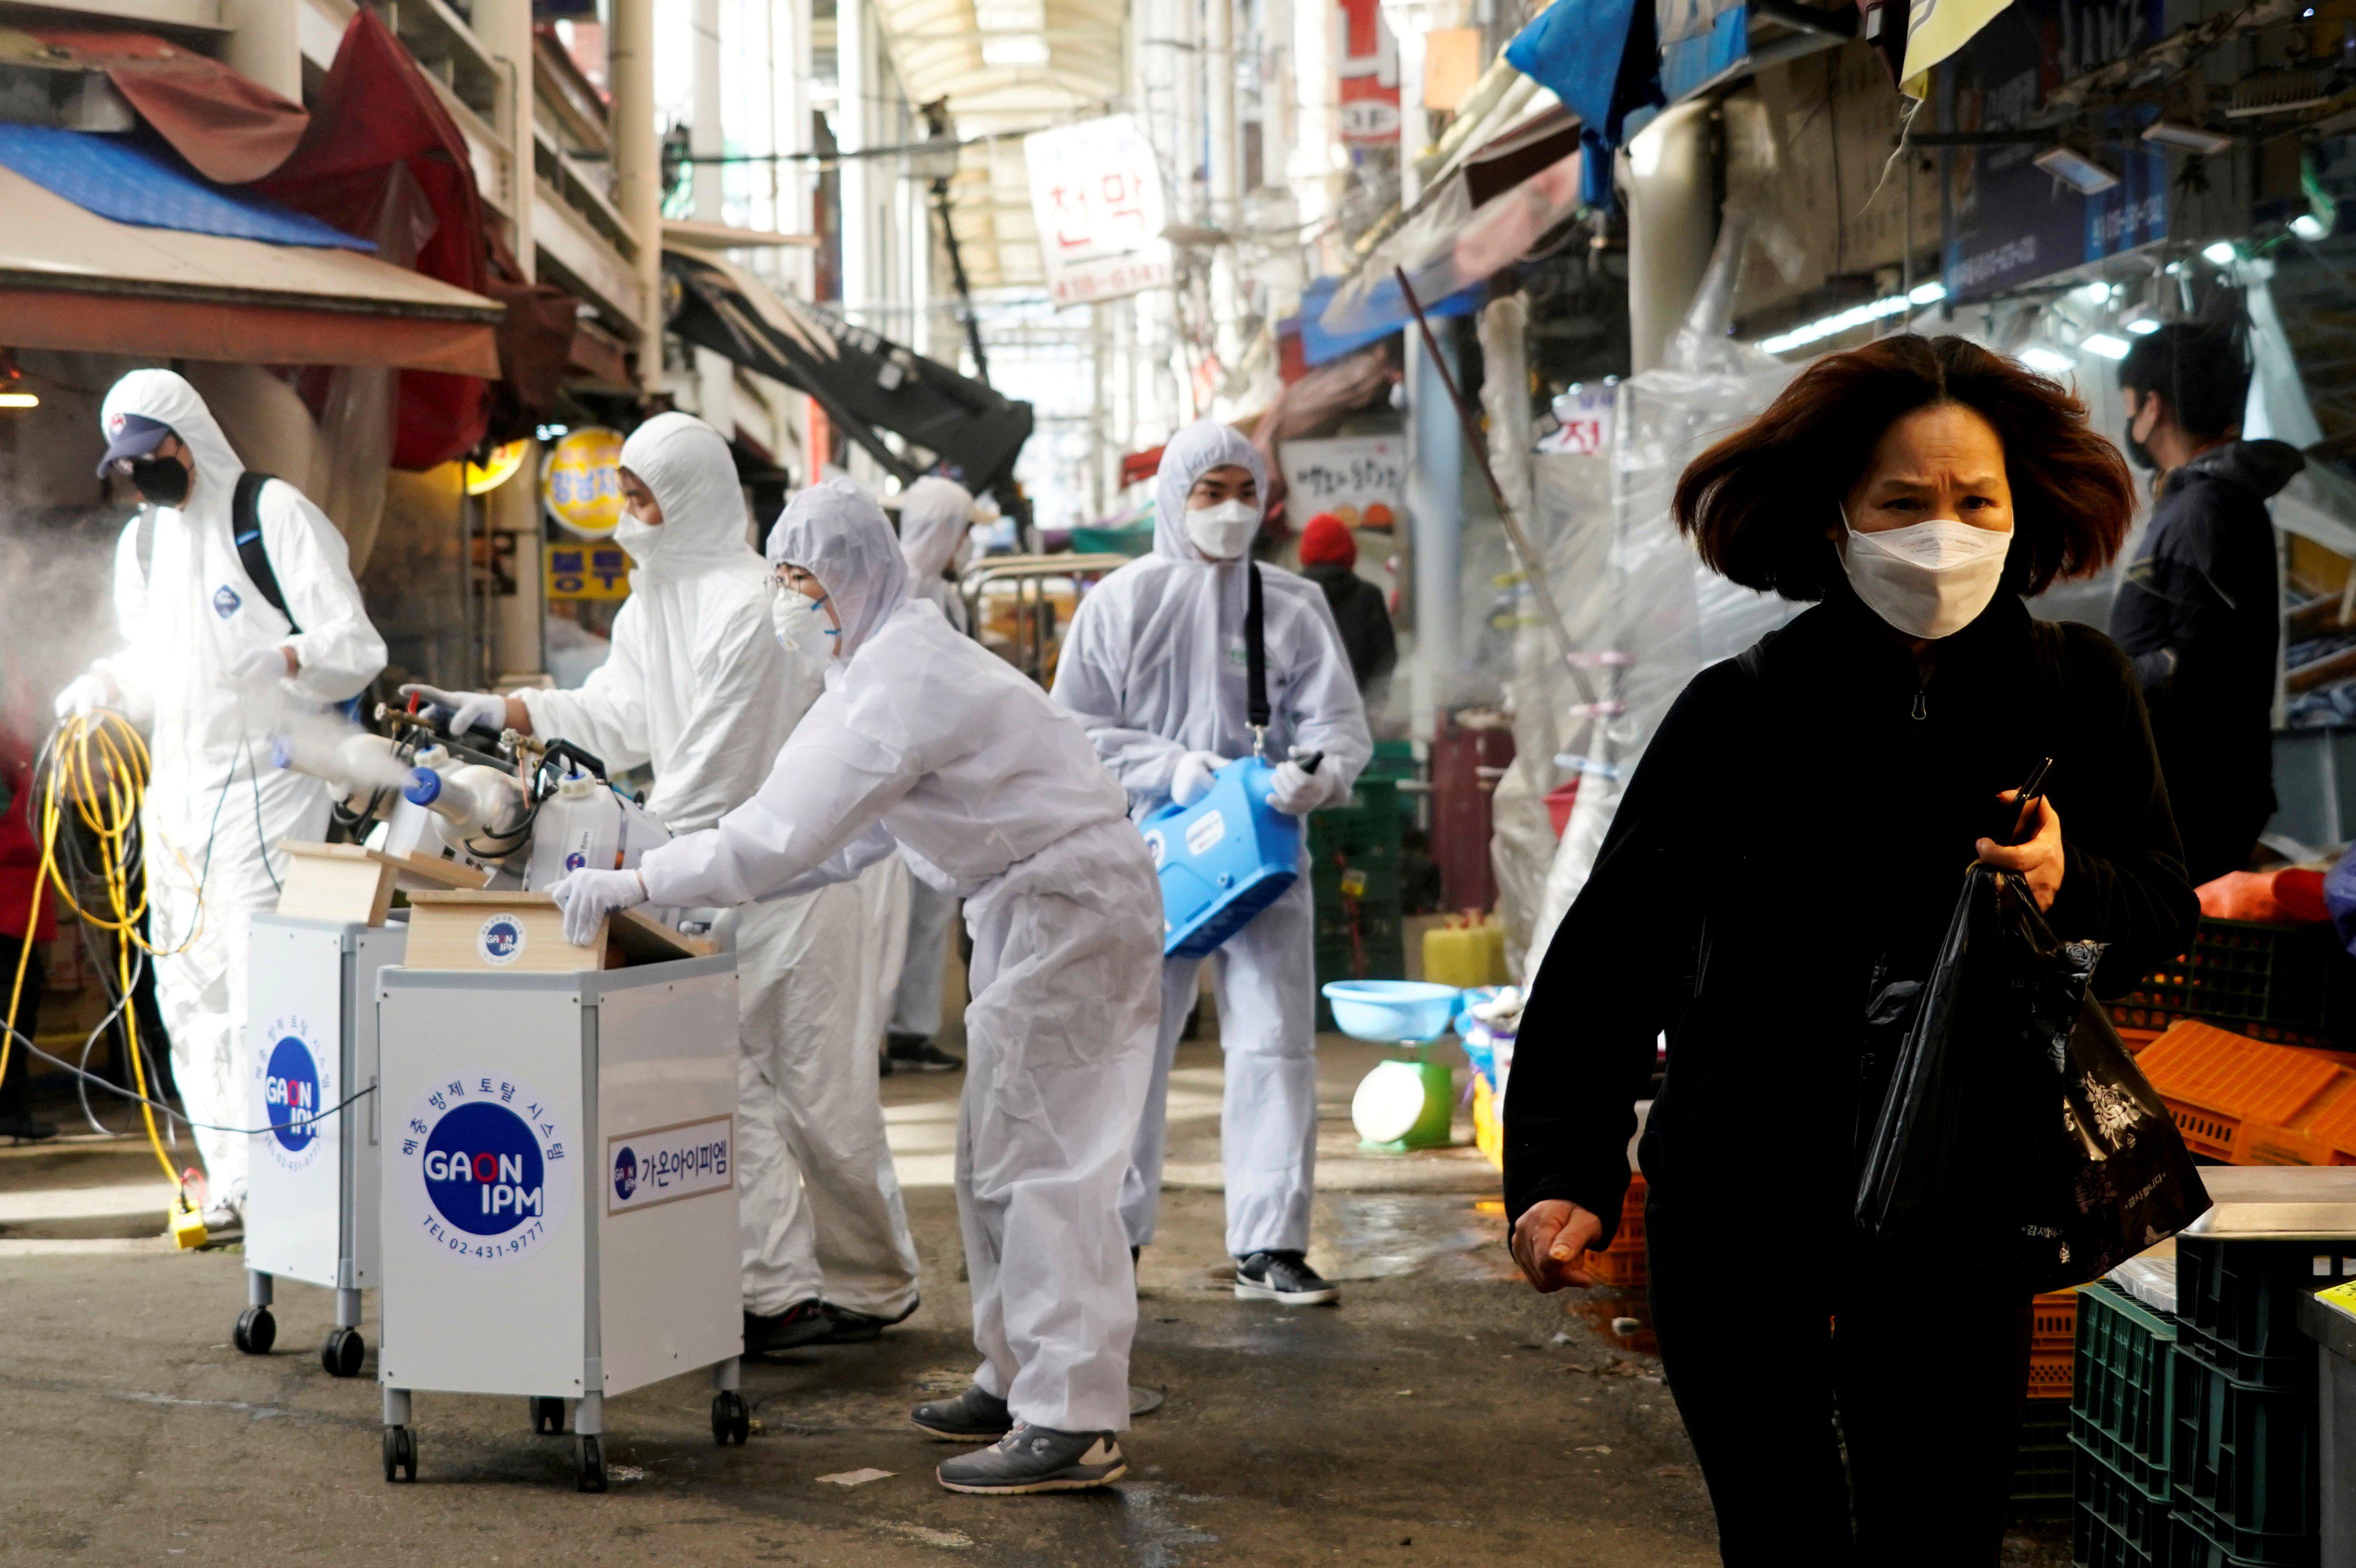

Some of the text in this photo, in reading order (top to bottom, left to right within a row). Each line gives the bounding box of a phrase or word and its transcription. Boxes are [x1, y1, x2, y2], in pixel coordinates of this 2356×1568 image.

[486, 934, 513, 943] GAON
[499, 943, 517, 952] IPM
[265, 1076, 312, 1108] GAON
[290, 1107, 320, 1137] IPM
[401, 1078, 565, 1161] 해충 방제 토탈 시스템
[424, 1150, 523, 1184] GAON
[642, 1139, 727, 1187] 가온아이피엠
[482, 1184, 543, 1217] IPM
[422, 1214, 544, 1258] TEL 02-431-9777
